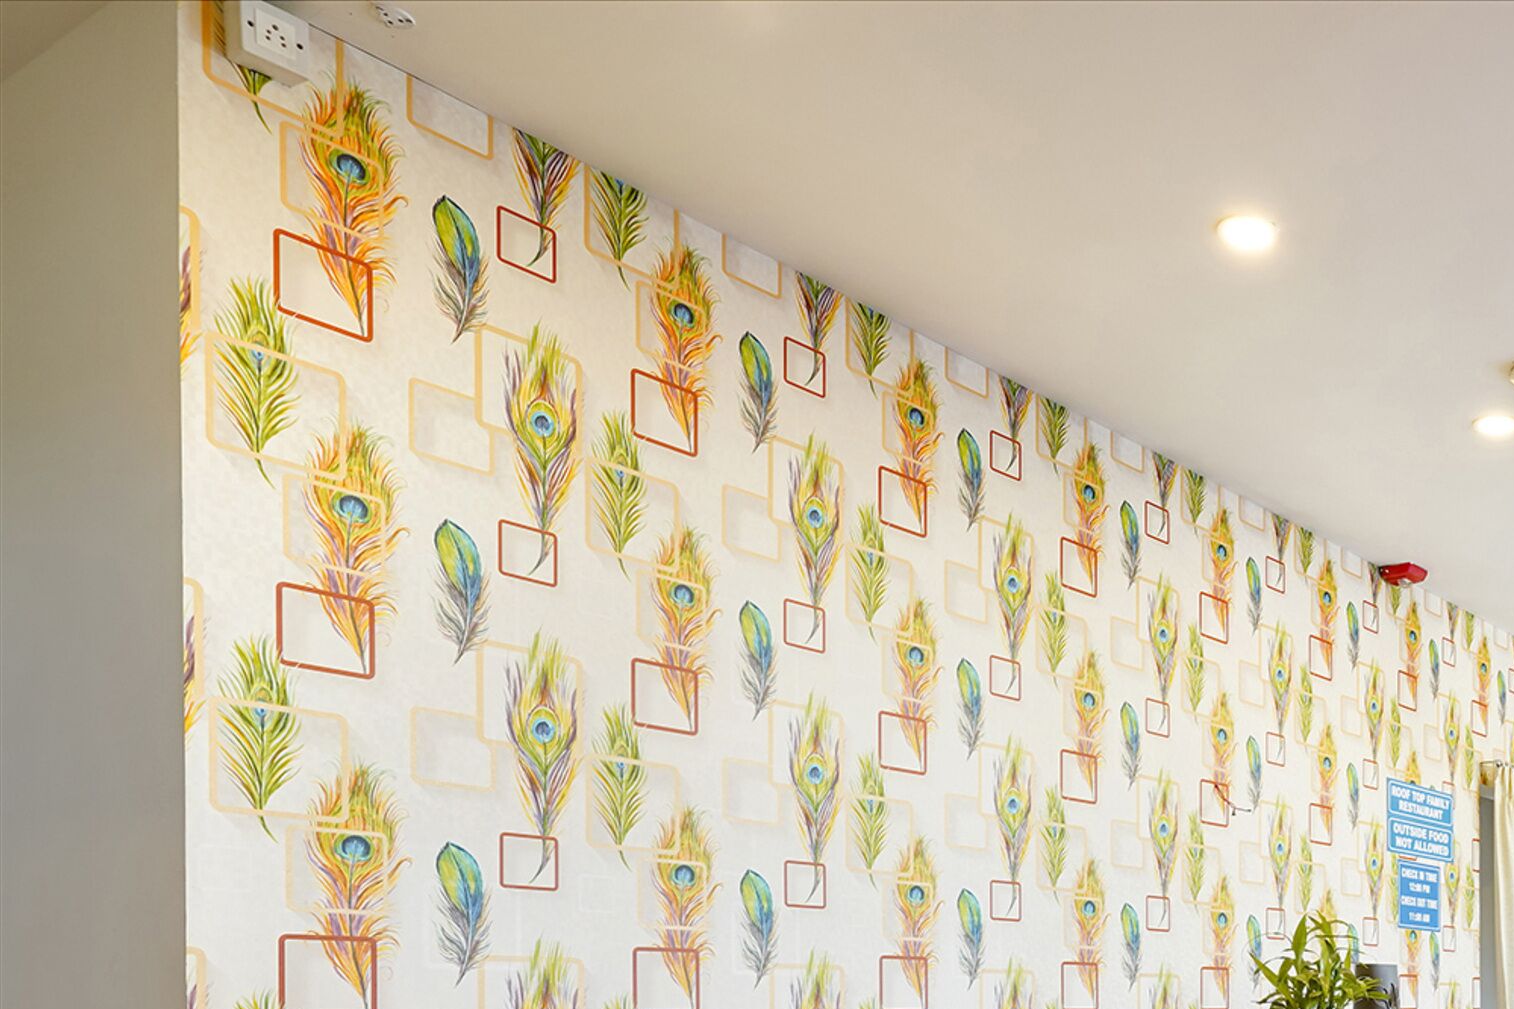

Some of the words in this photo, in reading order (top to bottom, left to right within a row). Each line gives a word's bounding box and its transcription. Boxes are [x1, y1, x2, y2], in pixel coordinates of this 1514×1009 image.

[1391, 785, 1411, 800] ROOF
[1412, 790, 1426, 803] TOP
[1427, 794, 1450, 810] FAMILY
[1398, 800, 1443, 820] RESTAURANT
[1393, 822, 1428, 838] OUTSIDE
[1428, 830, 1449, 844] FOOD
[1395, 836, 1412, 849] NOT
[1413, 840, 1449, 856] ALLOWED
[1402, 867, 1418, 880] CHECK
[1425, 872, 1438, 883] TIME
[1401, 895, 1417, 907] CHECK
[1417, 897, 1426, 908] OUT
[1426, 899, 1438, 910] TIME
